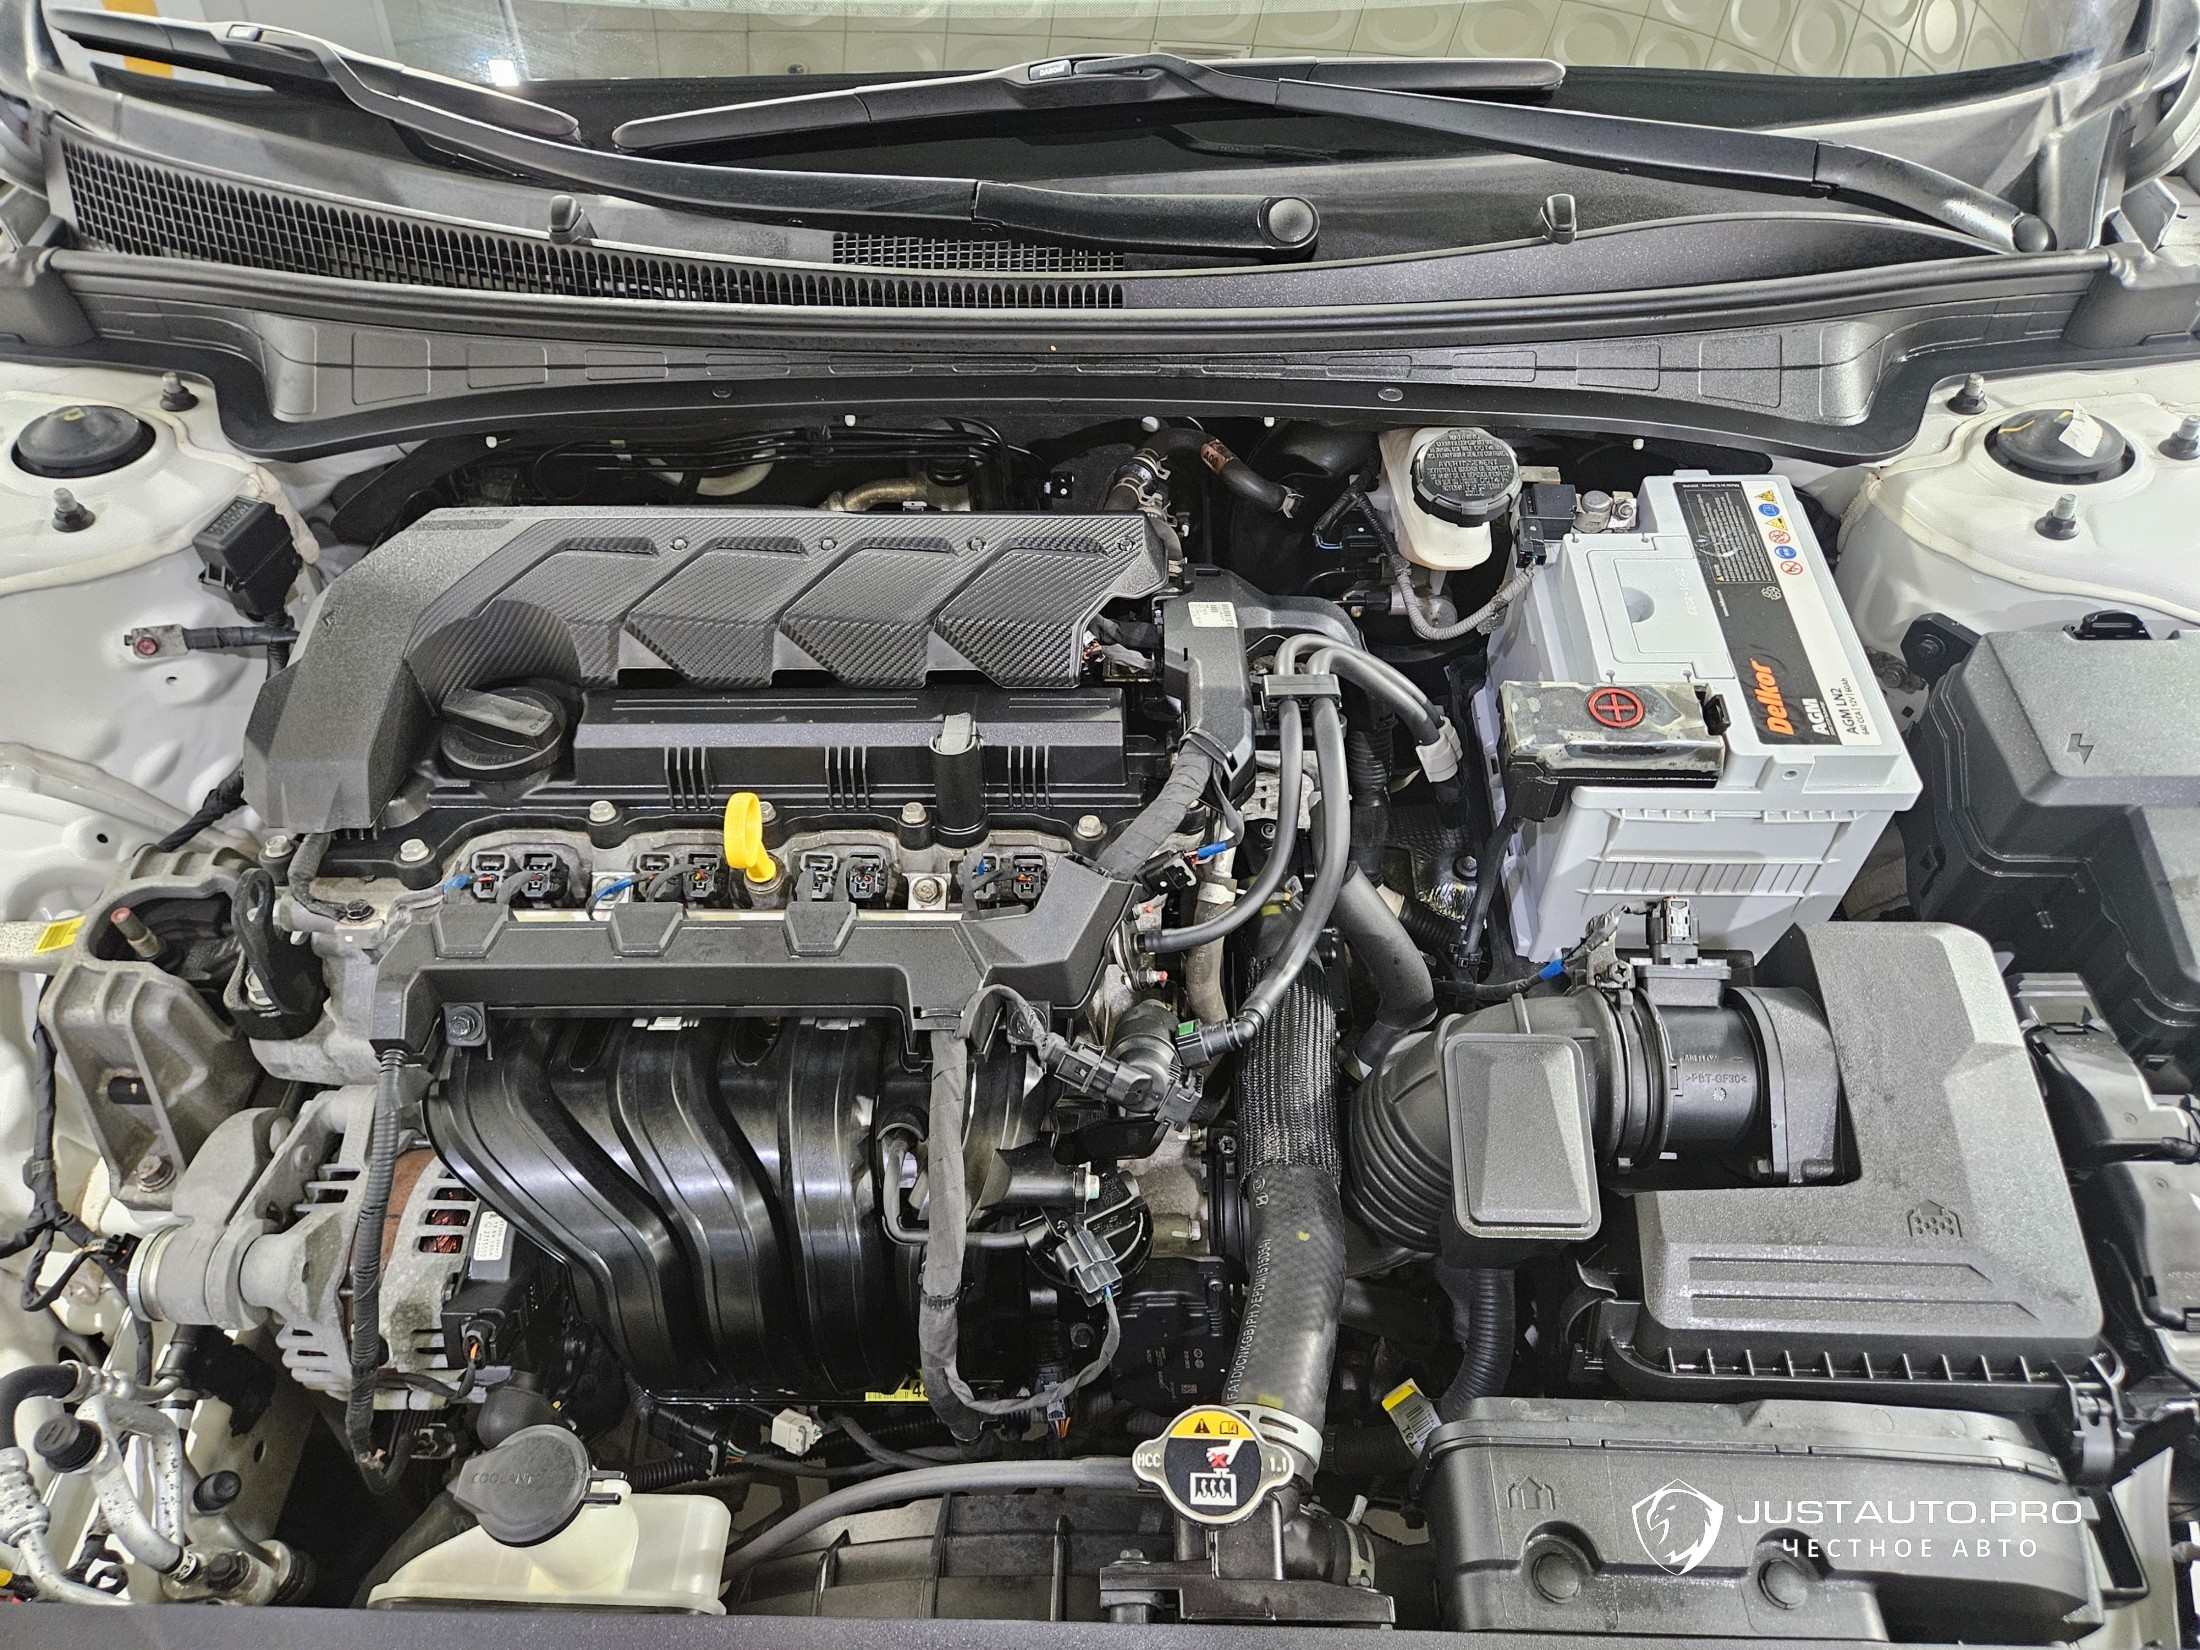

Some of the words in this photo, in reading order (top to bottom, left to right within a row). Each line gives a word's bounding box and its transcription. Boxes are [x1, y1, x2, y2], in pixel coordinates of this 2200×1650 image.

[1751, 659, 1795, 736] Delkor
[1830, 687, 1848, 706] LN2
[1801, 698, 1830, 736] AGM
[1839, 709, 1859, 735] AGM
[1137, 1453, 1162, 1467] HCC
[1269, 1456, 1288, 1472] 1.1
